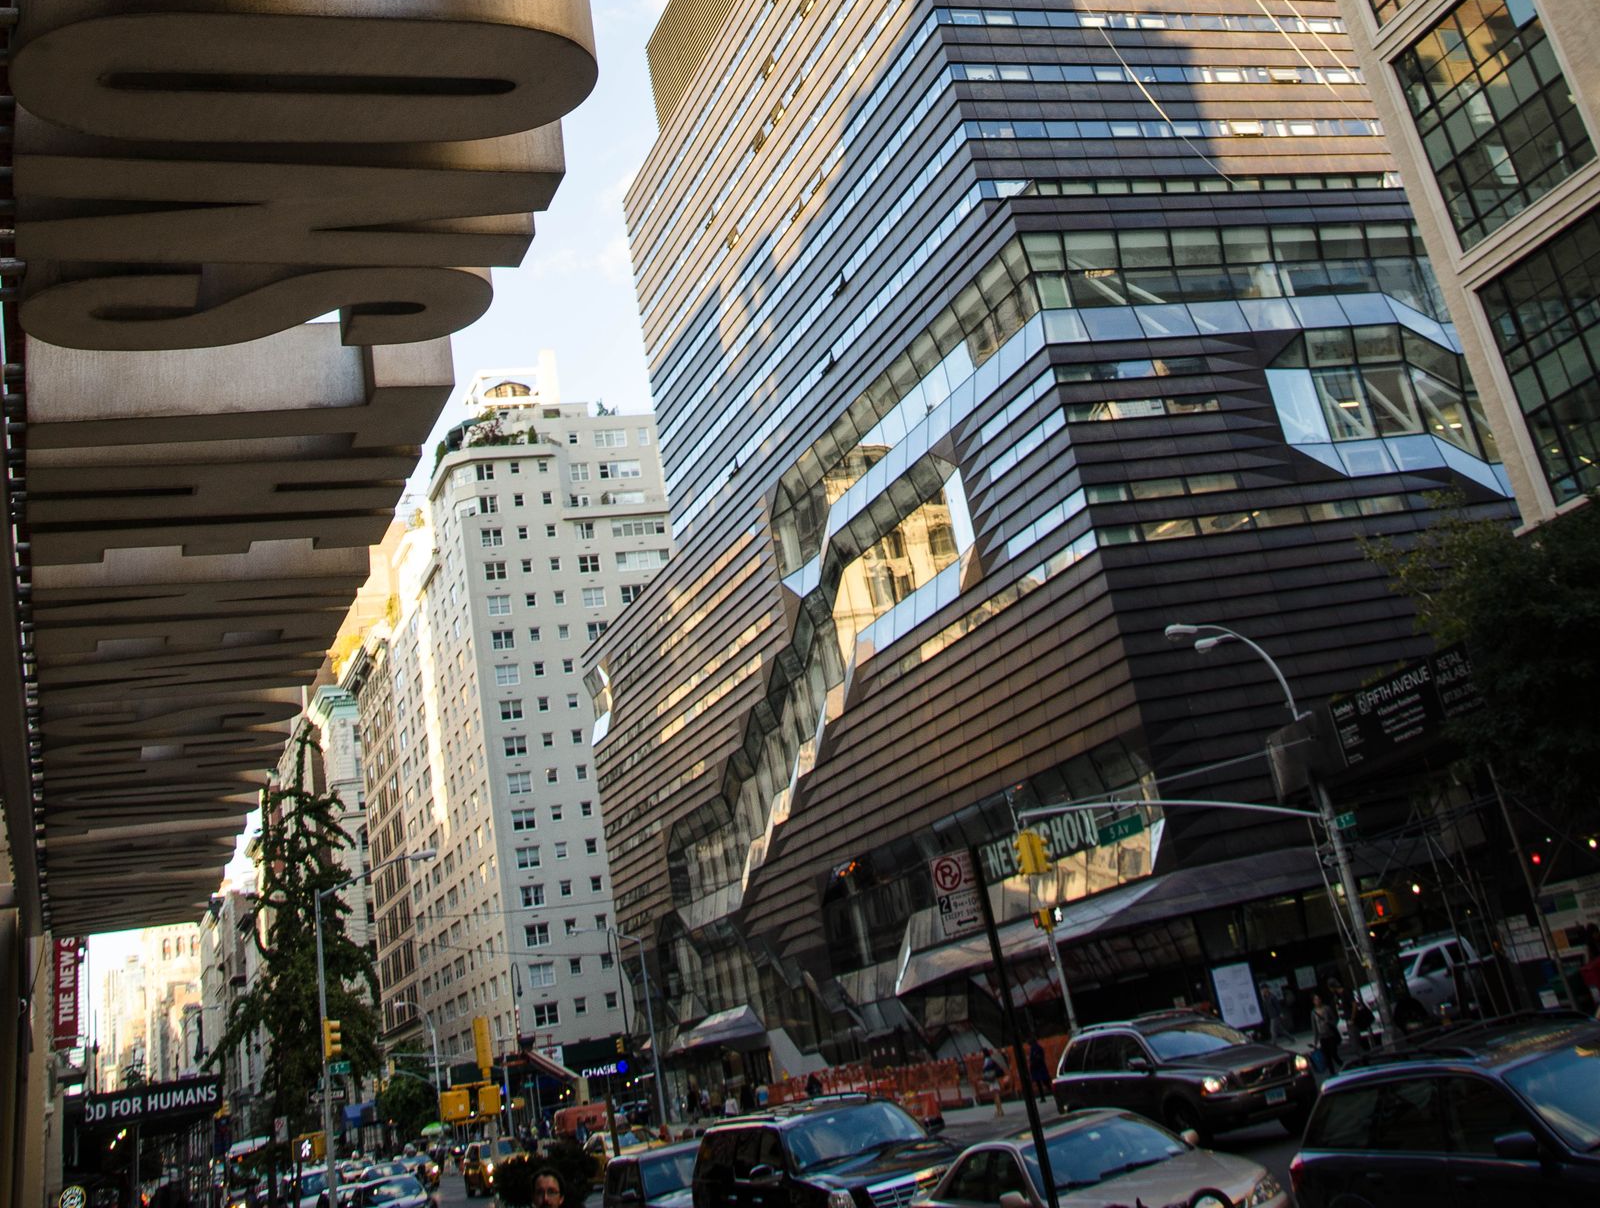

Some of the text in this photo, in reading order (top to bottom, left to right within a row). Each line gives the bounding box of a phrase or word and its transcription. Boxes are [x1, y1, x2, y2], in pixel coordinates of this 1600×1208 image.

[25, 367, 454, 567] THE
[1366, 684, 1392, 706] FIFTH
[1392, 666, 1430, 695] AVENUE
[1030, 809, 1099, 858] CHOOL
[1109, 827, 1116, 839] 5
[59, 951, 75, 989] NEW
[59, 991, 75, 1026] THE
[581, 1062, 618, 1078] CHASE
[111, 1096, 144, 1118] FOR
[146, 1084, 218, 1112] HUMANS
